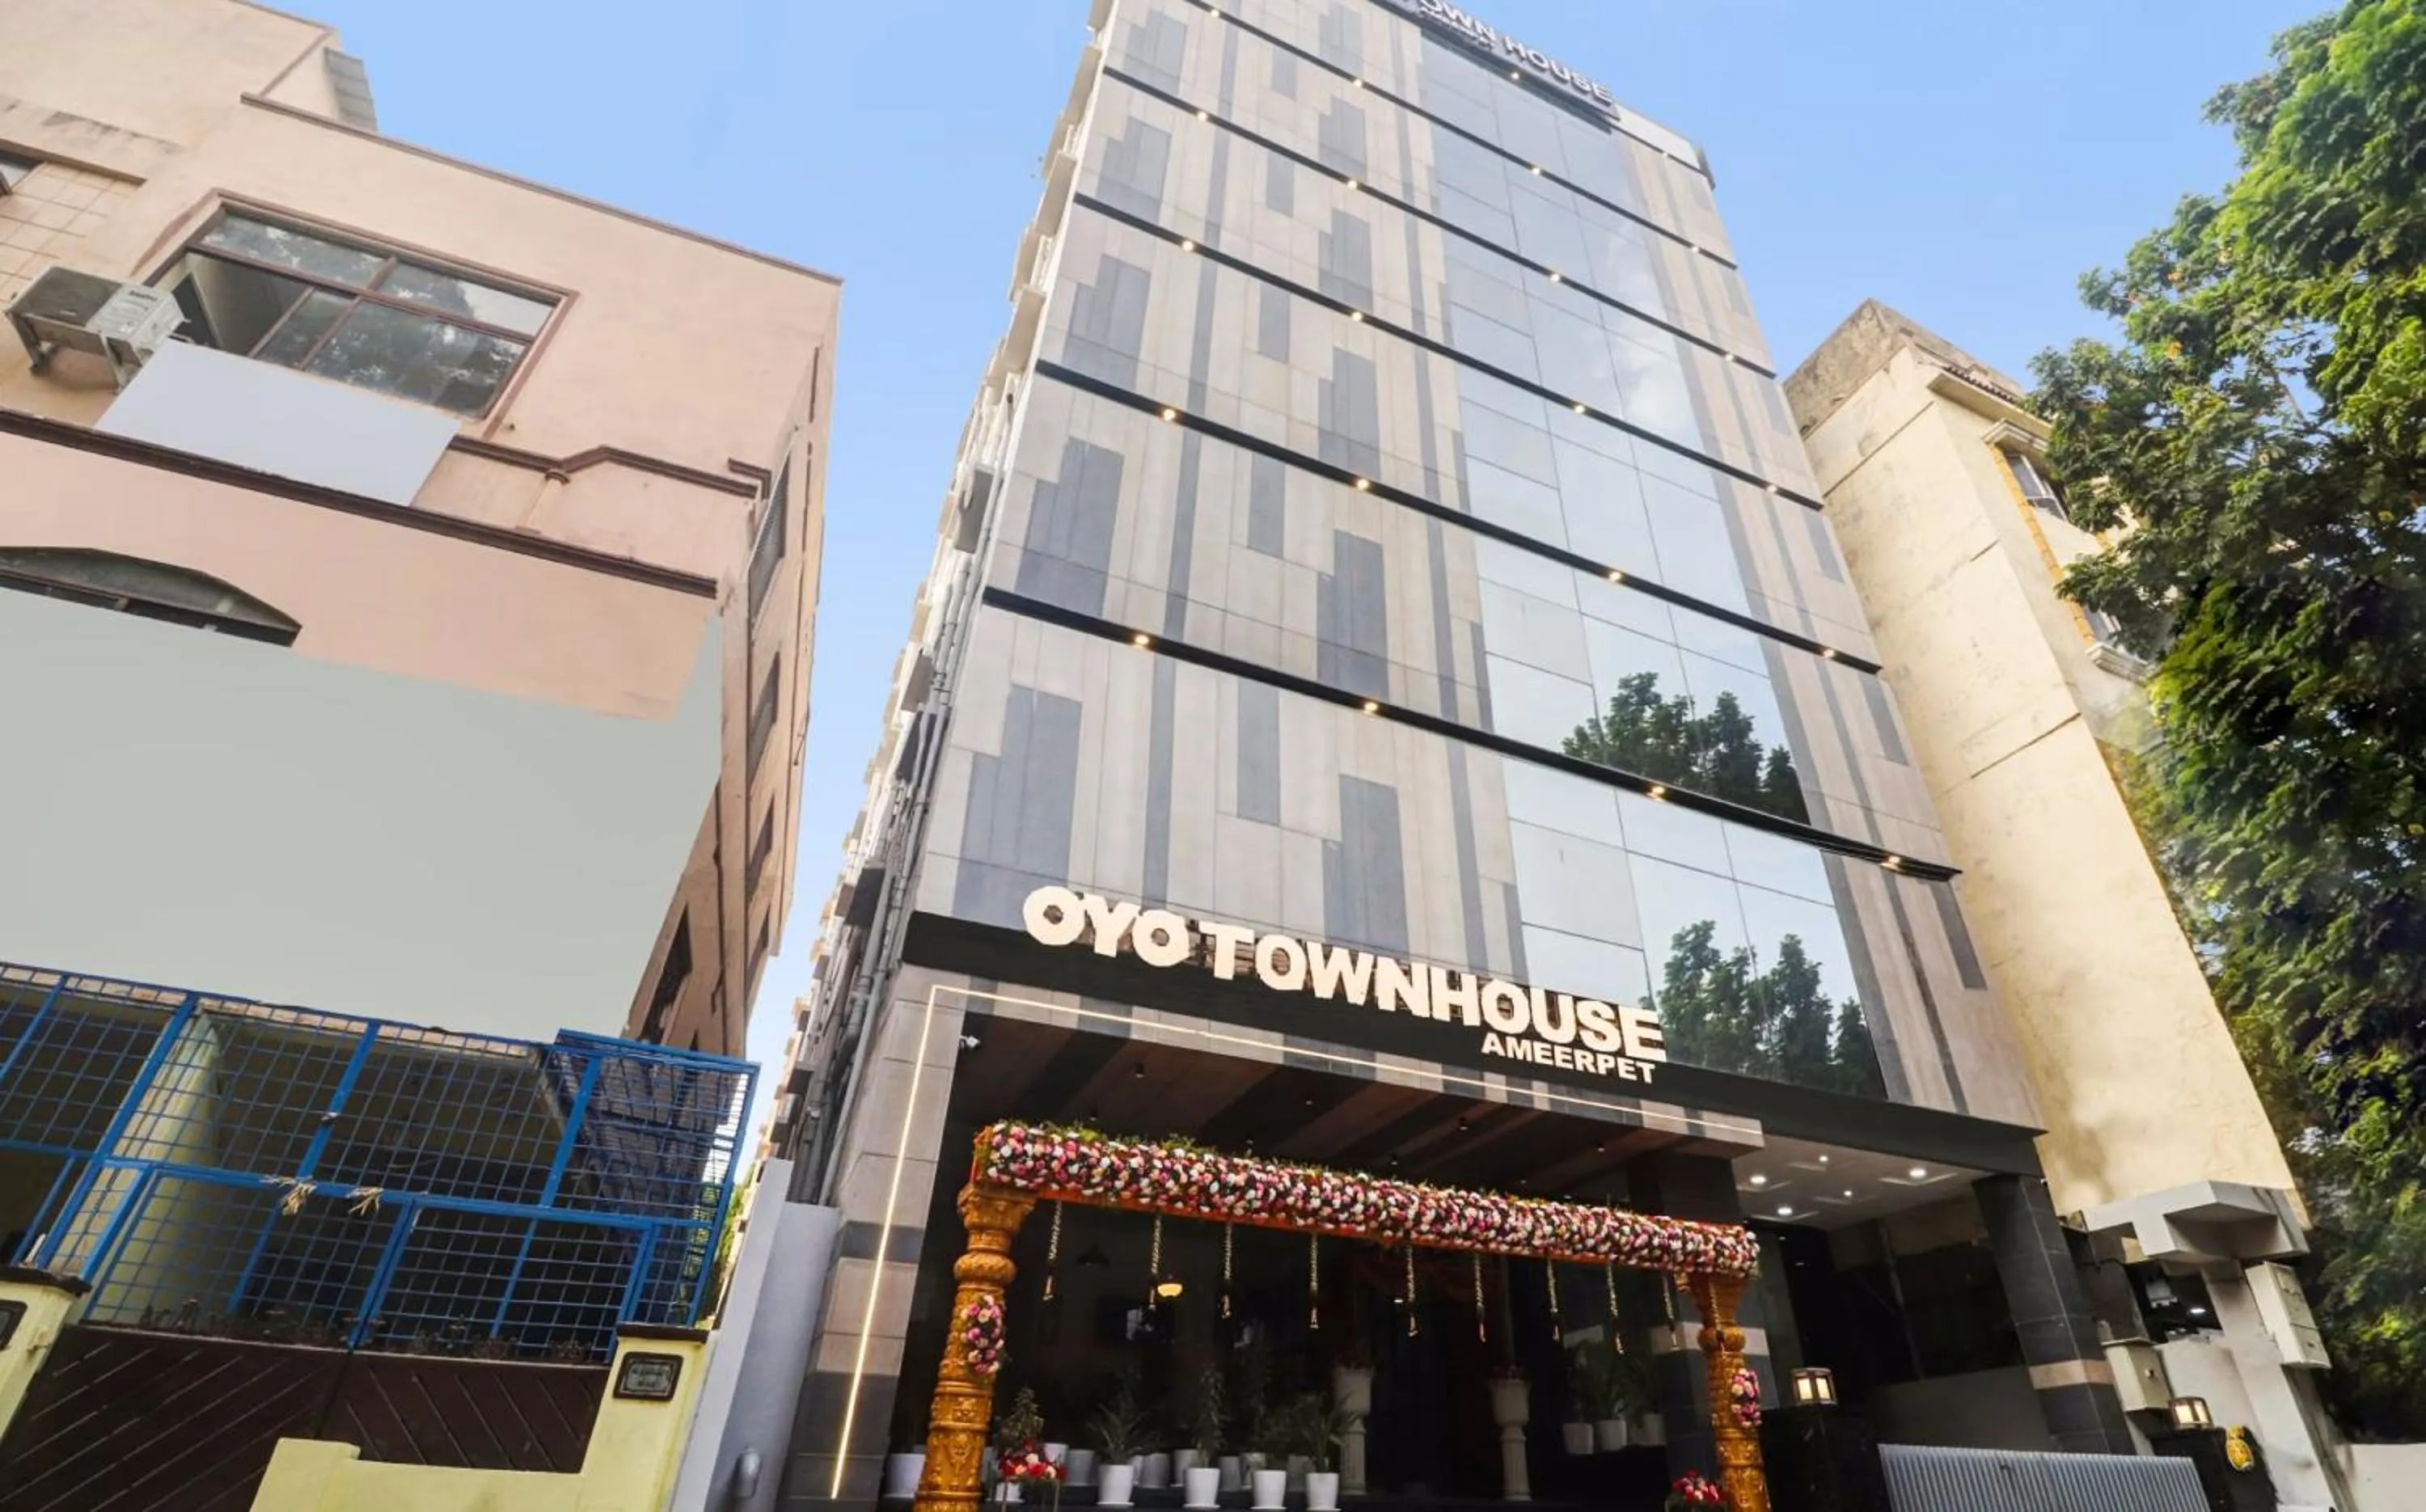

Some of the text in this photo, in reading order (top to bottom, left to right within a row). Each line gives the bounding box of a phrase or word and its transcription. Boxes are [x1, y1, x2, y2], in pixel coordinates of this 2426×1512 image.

[1504, 35, 1614, 104] HOUSE
[1022, 885, 1667, 1062] OYO TOWNHOUSE
[1481, 1033, 1656, 1084] AMEERPET
